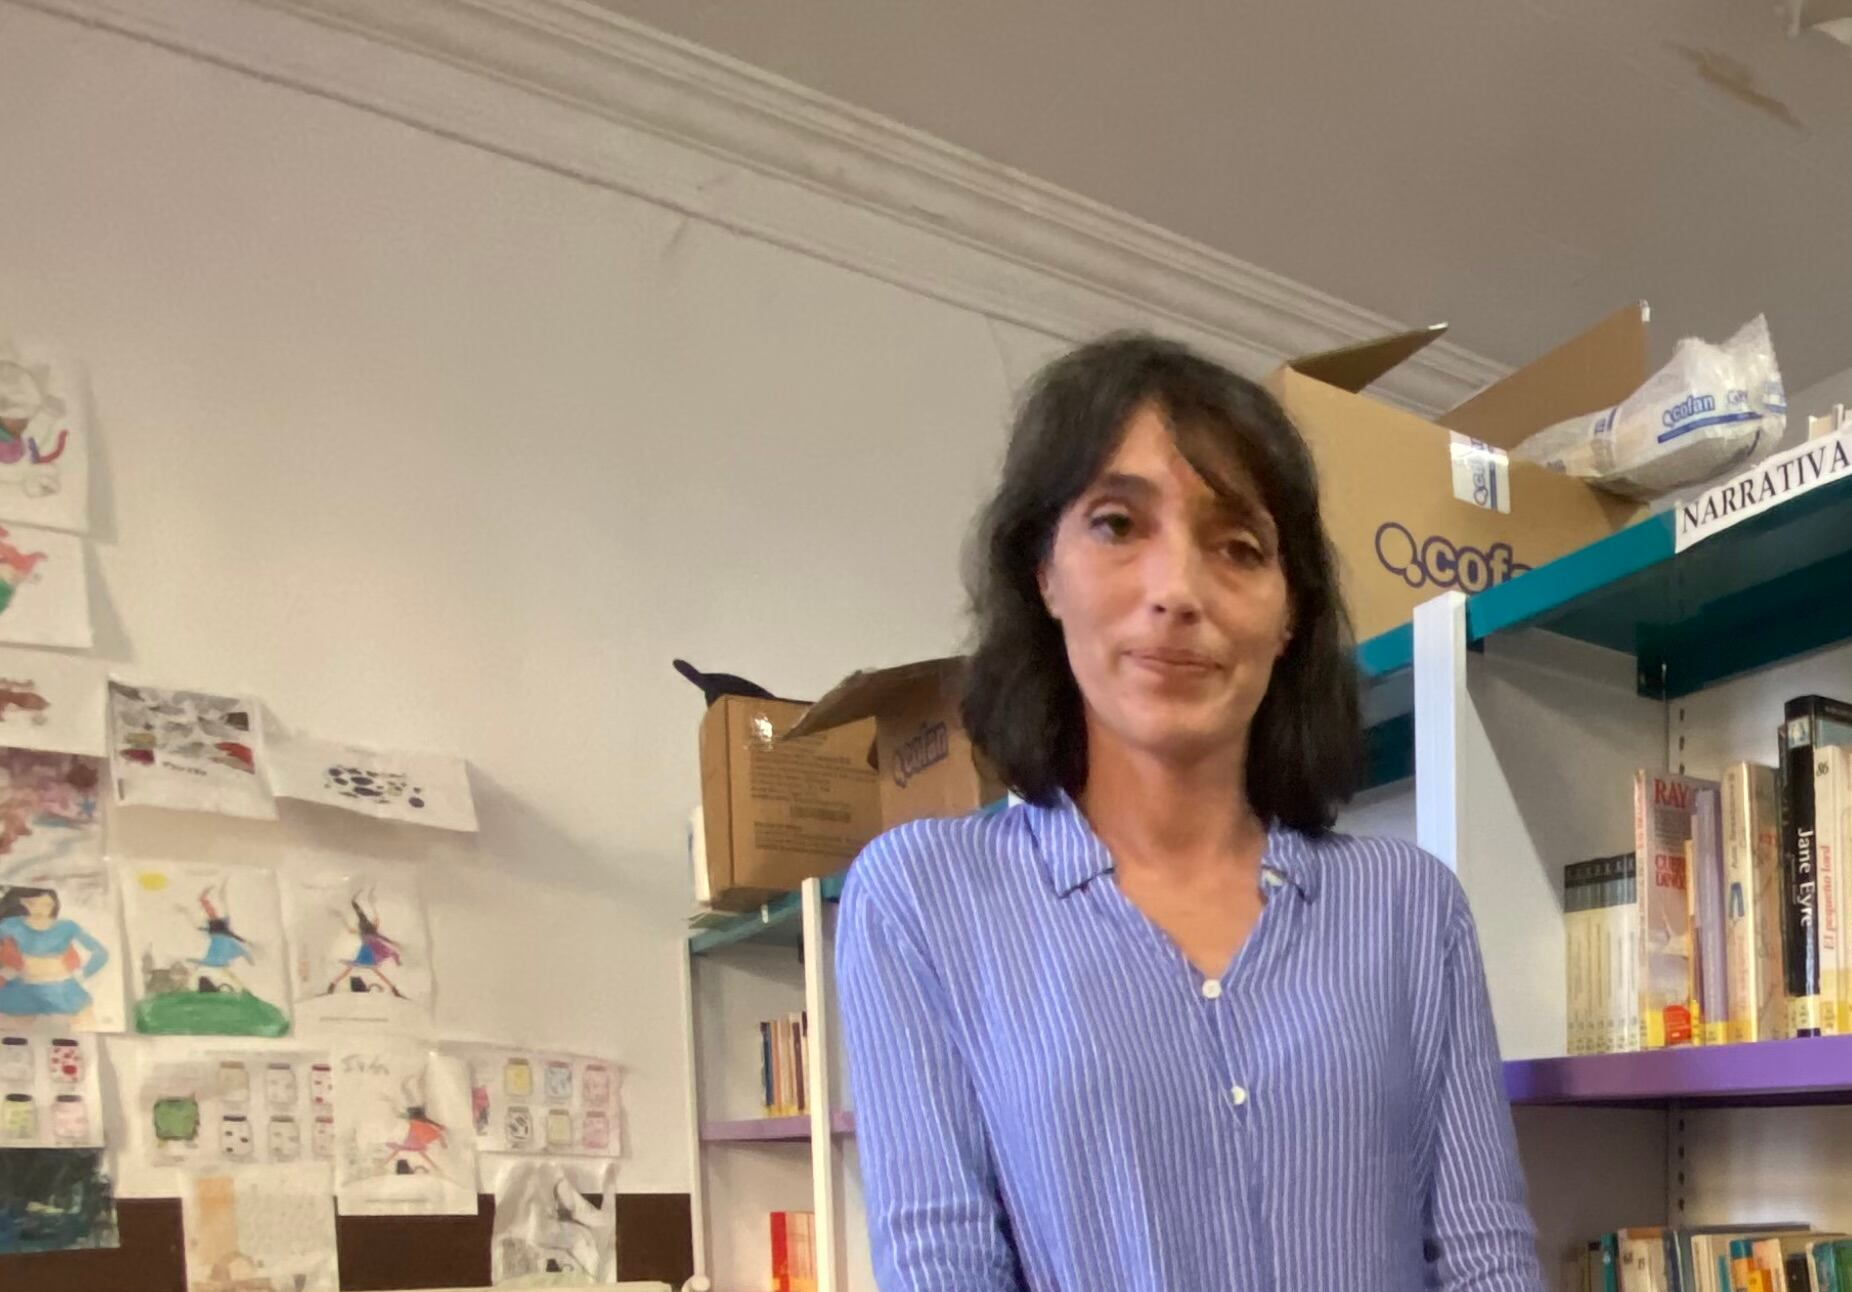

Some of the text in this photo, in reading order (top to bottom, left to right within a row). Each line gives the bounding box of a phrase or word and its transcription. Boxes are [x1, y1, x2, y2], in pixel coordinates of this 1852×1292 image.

[1671, 394, 1715, 424] cofan
[1682, 440, 1850, 533] NARRATIVA
[1421, 535, 1532, 594] cof
[1797, 828, 1816, 927] Jane Eyre
